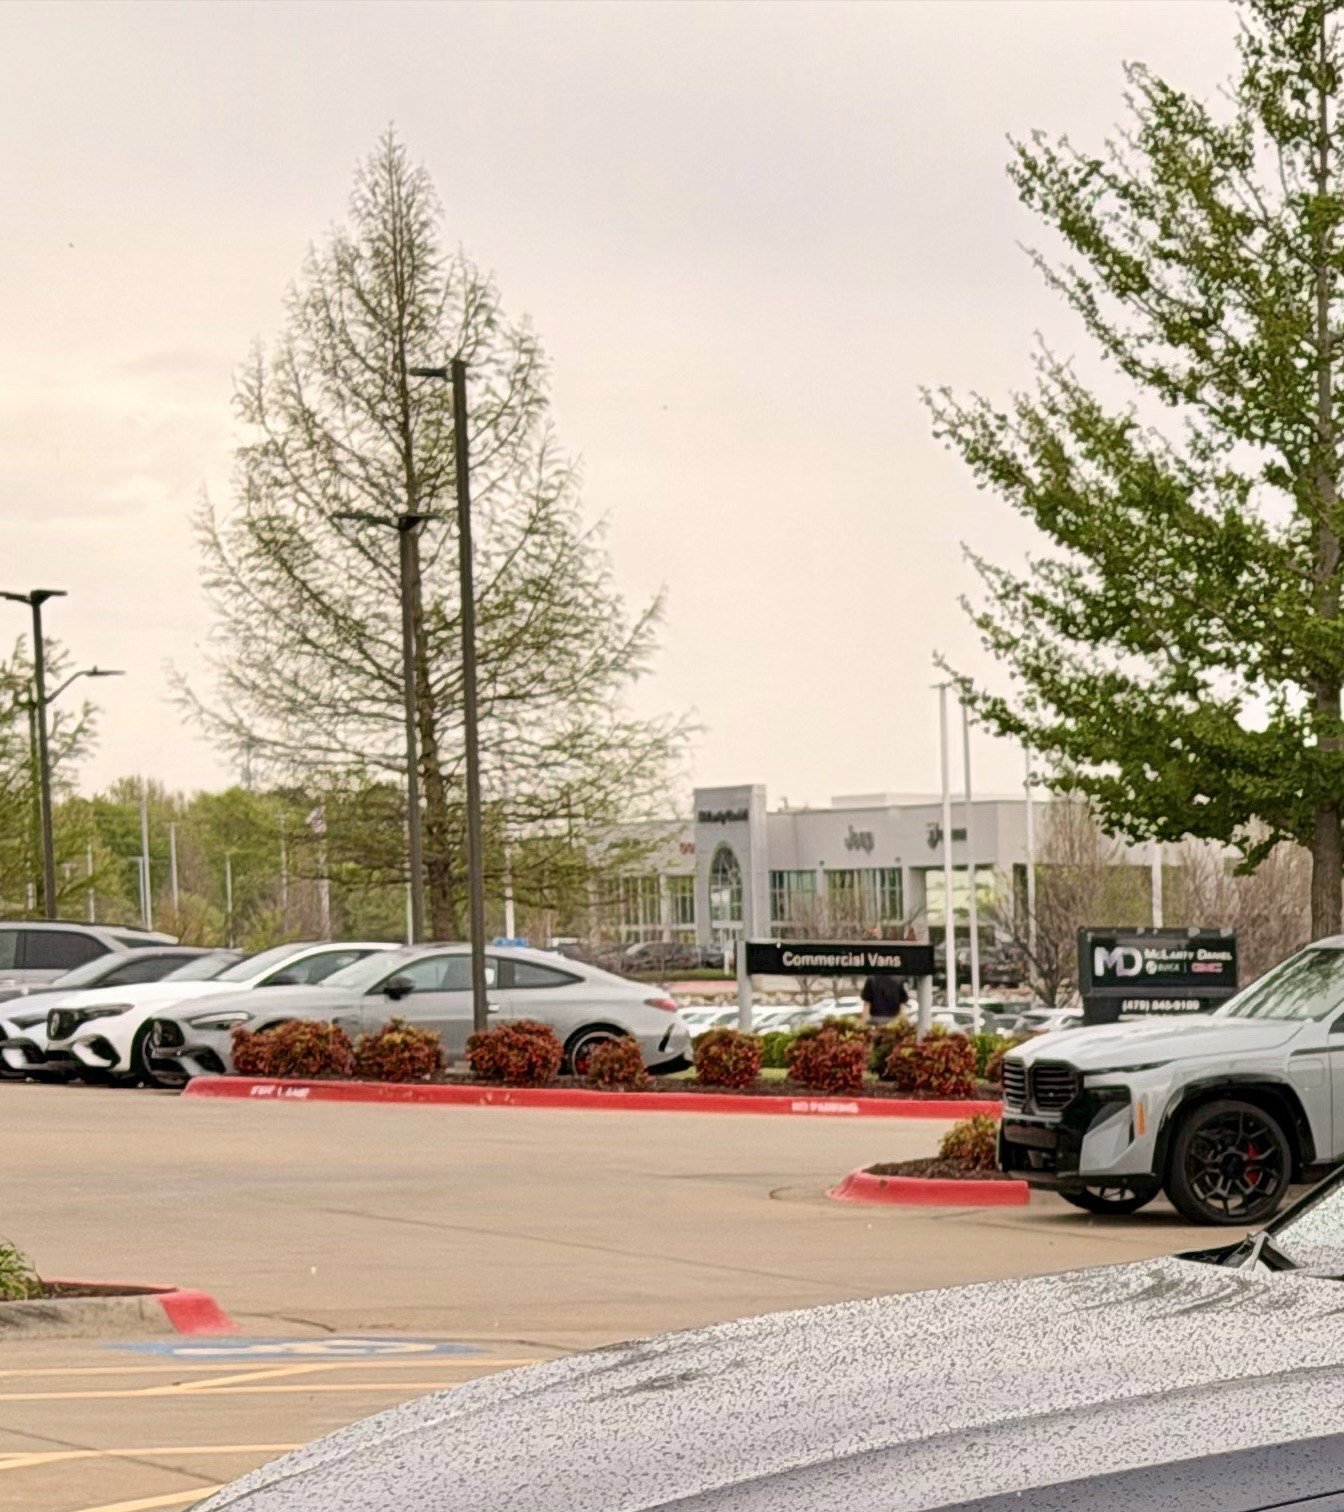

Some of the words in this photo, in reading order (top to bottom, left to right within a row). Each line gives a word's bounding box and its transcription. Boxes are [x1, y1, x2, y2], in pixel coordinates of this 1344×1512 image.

[782, 951, 865, 967] Commercial
[867, 952, 902, 968] Vans
[1094, 946, 1143, 977] MD
